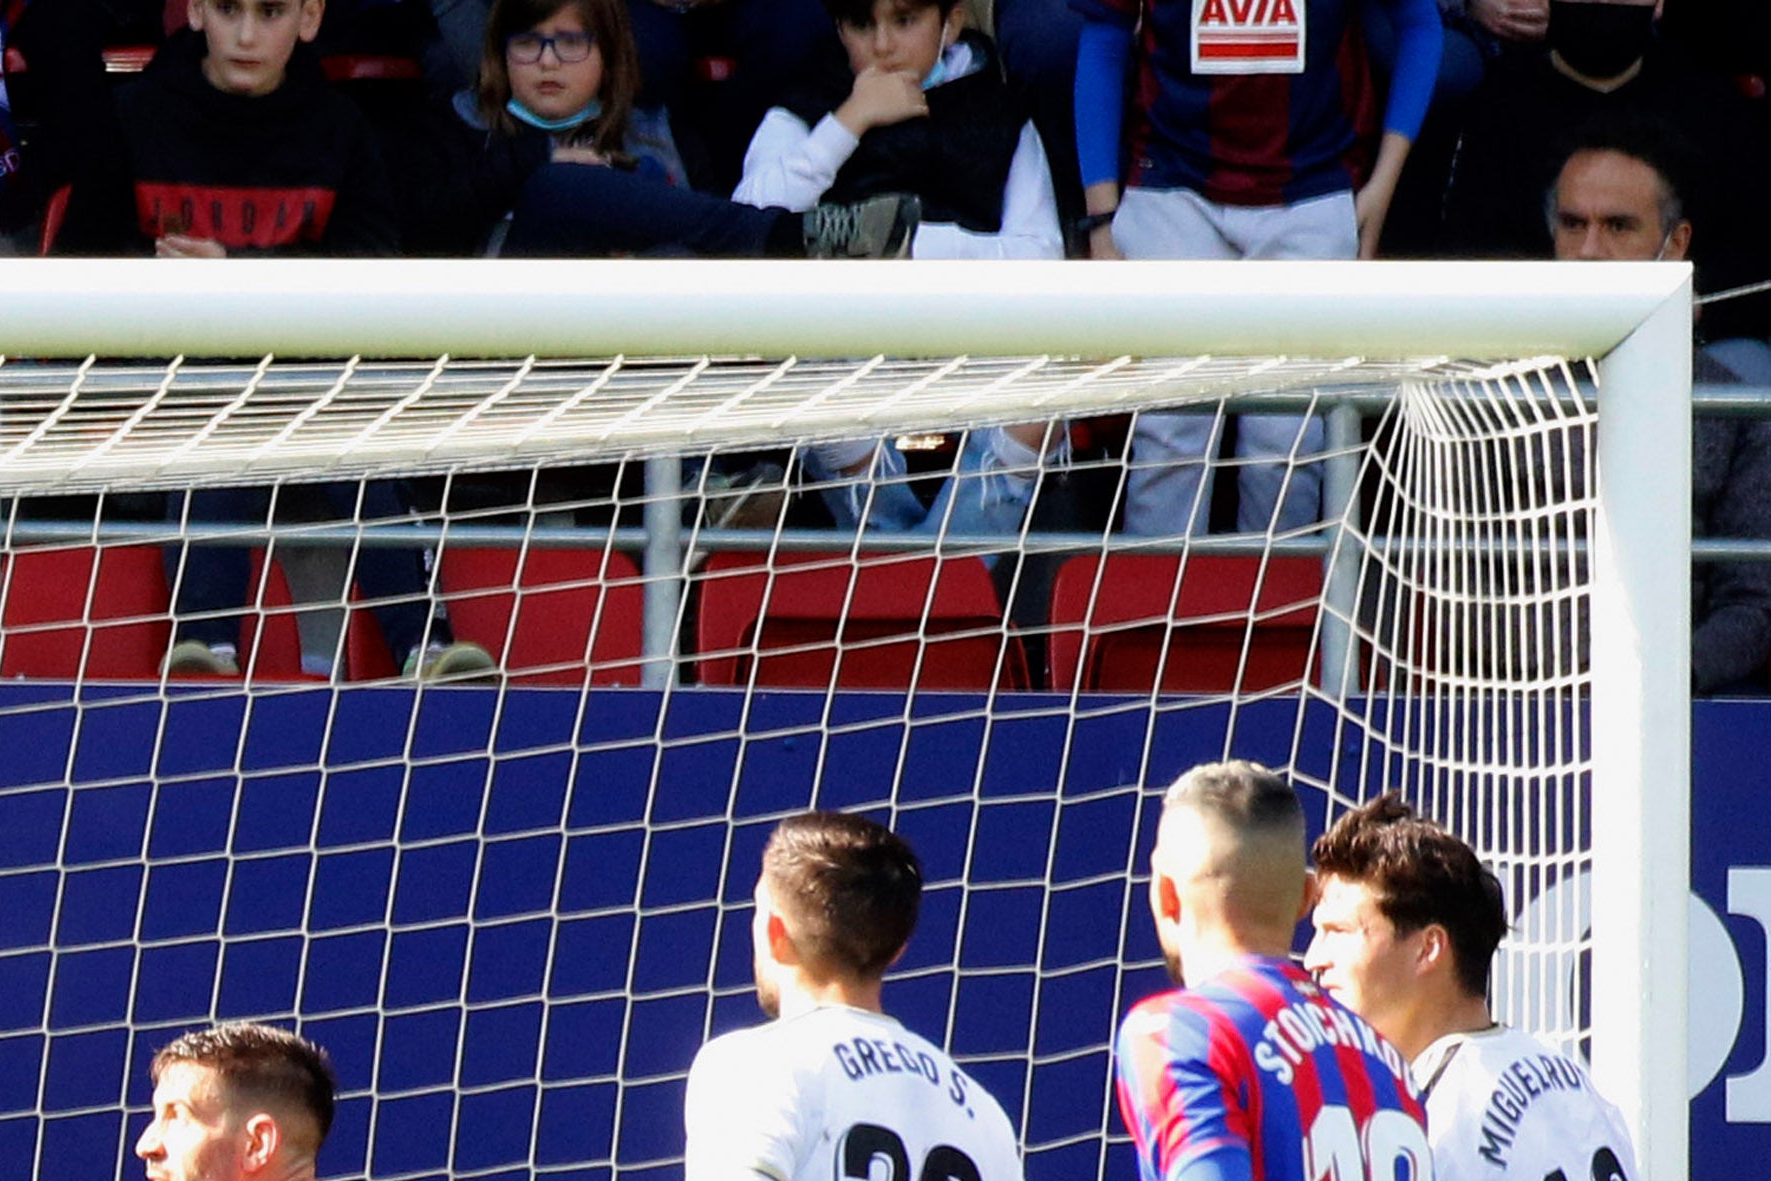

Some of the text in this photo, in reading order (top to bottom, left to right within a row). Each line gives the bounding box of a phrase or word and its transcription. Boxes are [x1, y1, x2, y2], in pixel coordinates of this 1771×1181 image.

[1198, 0, 1298, 26] AVIA
[833, 1037, 975, 1119] GREGO S.
